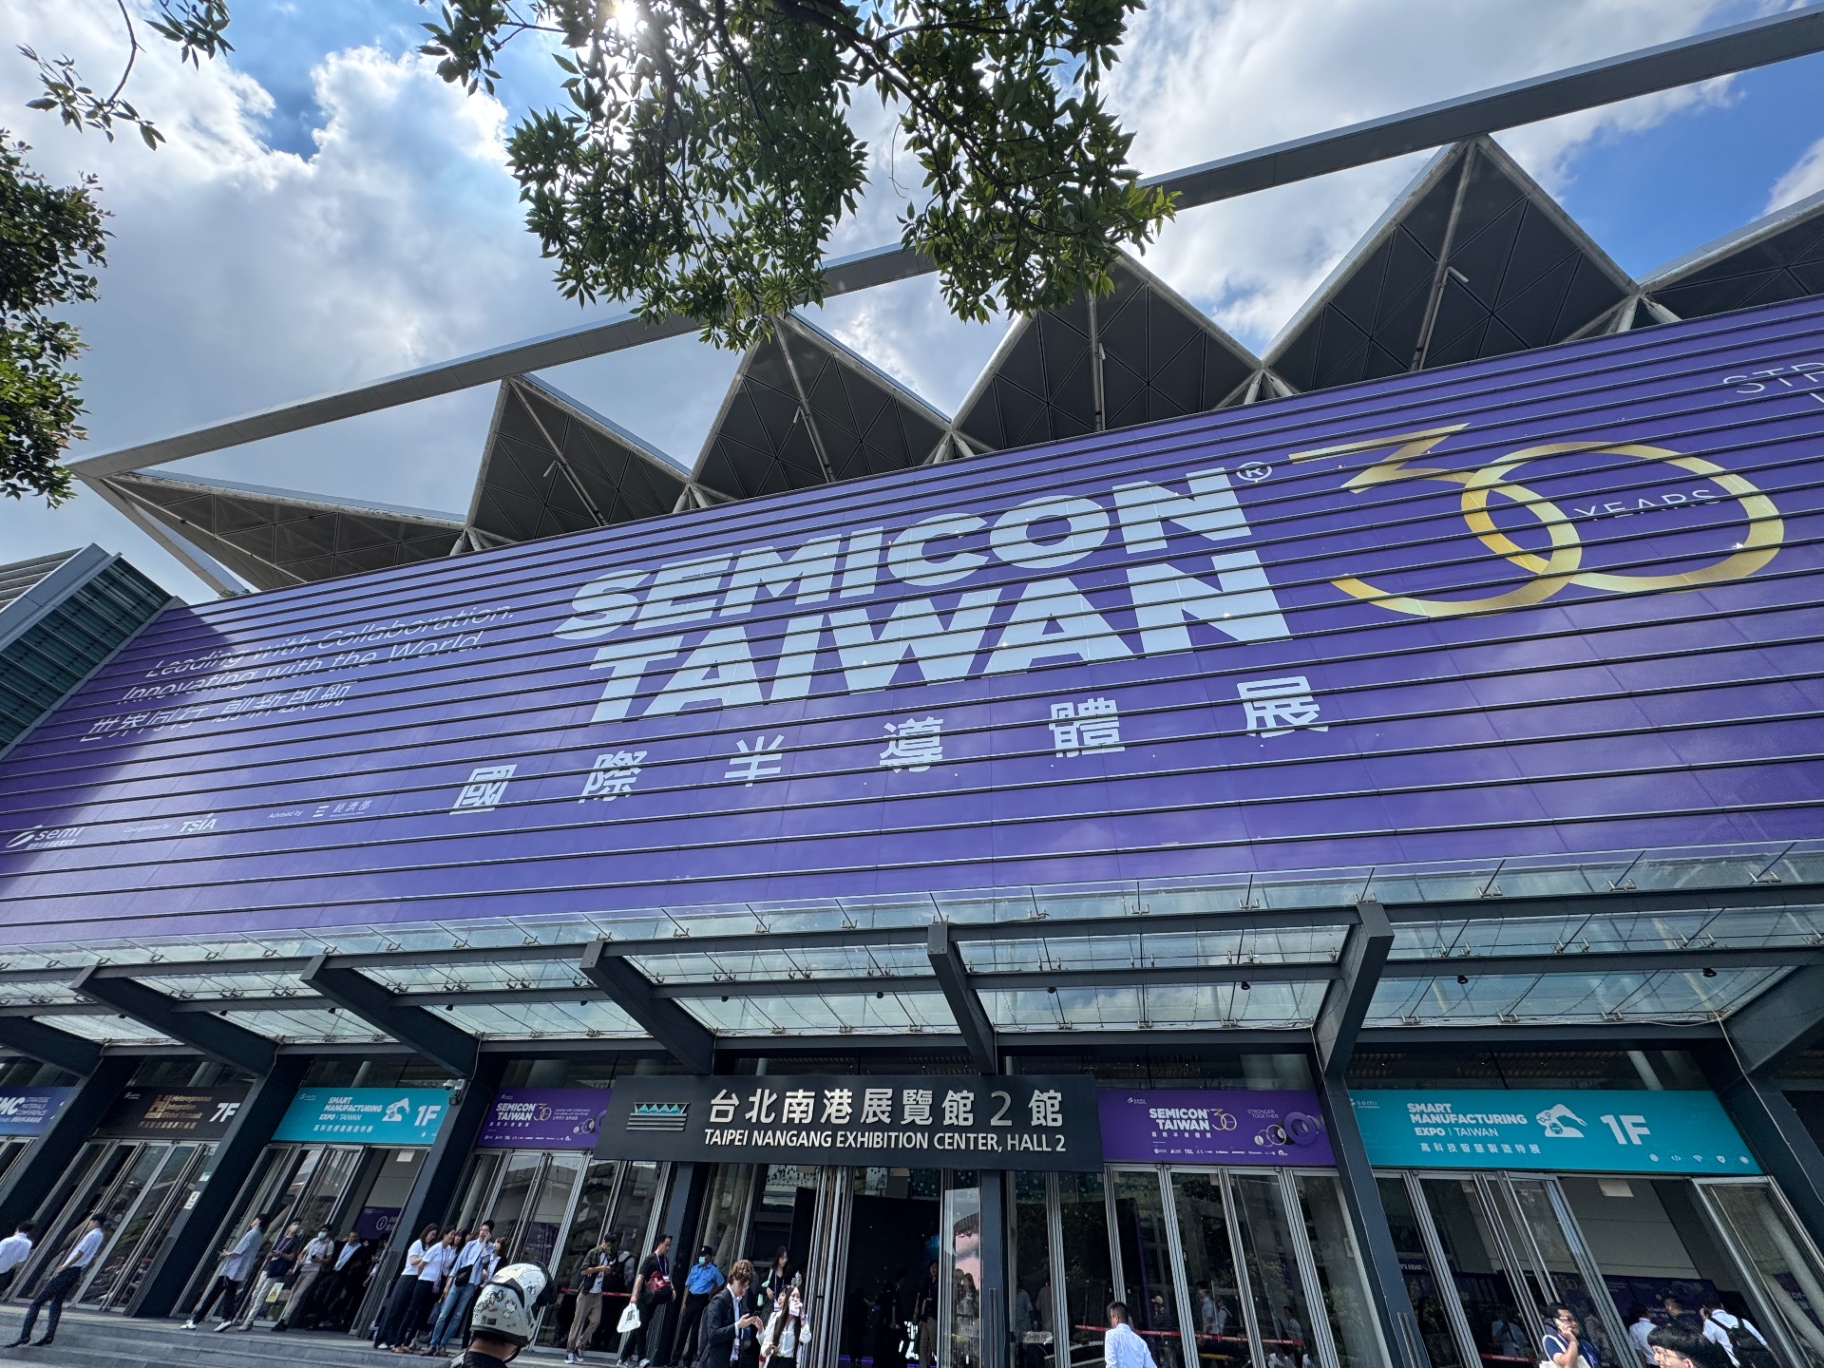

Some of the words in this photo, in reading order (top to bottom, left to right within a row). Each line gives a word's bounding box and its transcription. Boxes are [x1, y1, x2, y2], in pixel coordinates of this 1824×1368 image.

[588, 551, 1292, 727] TAIWAN
[145, 650, 249, 678] Leading
[253, 636, 311, 660] with
[122, 671, 258, 704] Innovating
[262, 657, 325, 682] with
[328, 651, 377, 672] the
[449, 675, 1330, 816] 國際半導體展
[209, 1103, 241, 1122] 7F
[414, 1105, 441, 1126] 1F
[497, 1112, 533, 1120] TAIWAN
[1407, 1103, 1452, 1113] SMART
[1156, 1119, 1210, 1130] TAIWAN
[1409, 1114, 1528, 1125] MANUFACTURING
[1600, 1114, 1651, 1145] 1F
[704, 1129, 749, 1146] TAIPEI
[751, 1130, 832, 1148] NANGANG
[836, 1131, 928, 1149] EXHIBITION
[933, 1133, 1002, 1152] CENTER,
[1007, 1134, 1052, 1151] HALL
[1055, 1134, 1066, 1151] 2
[1414, 1127, 1445, 1136] EXPO
[1453, 1127, 1499, 1137] TAIWAN
